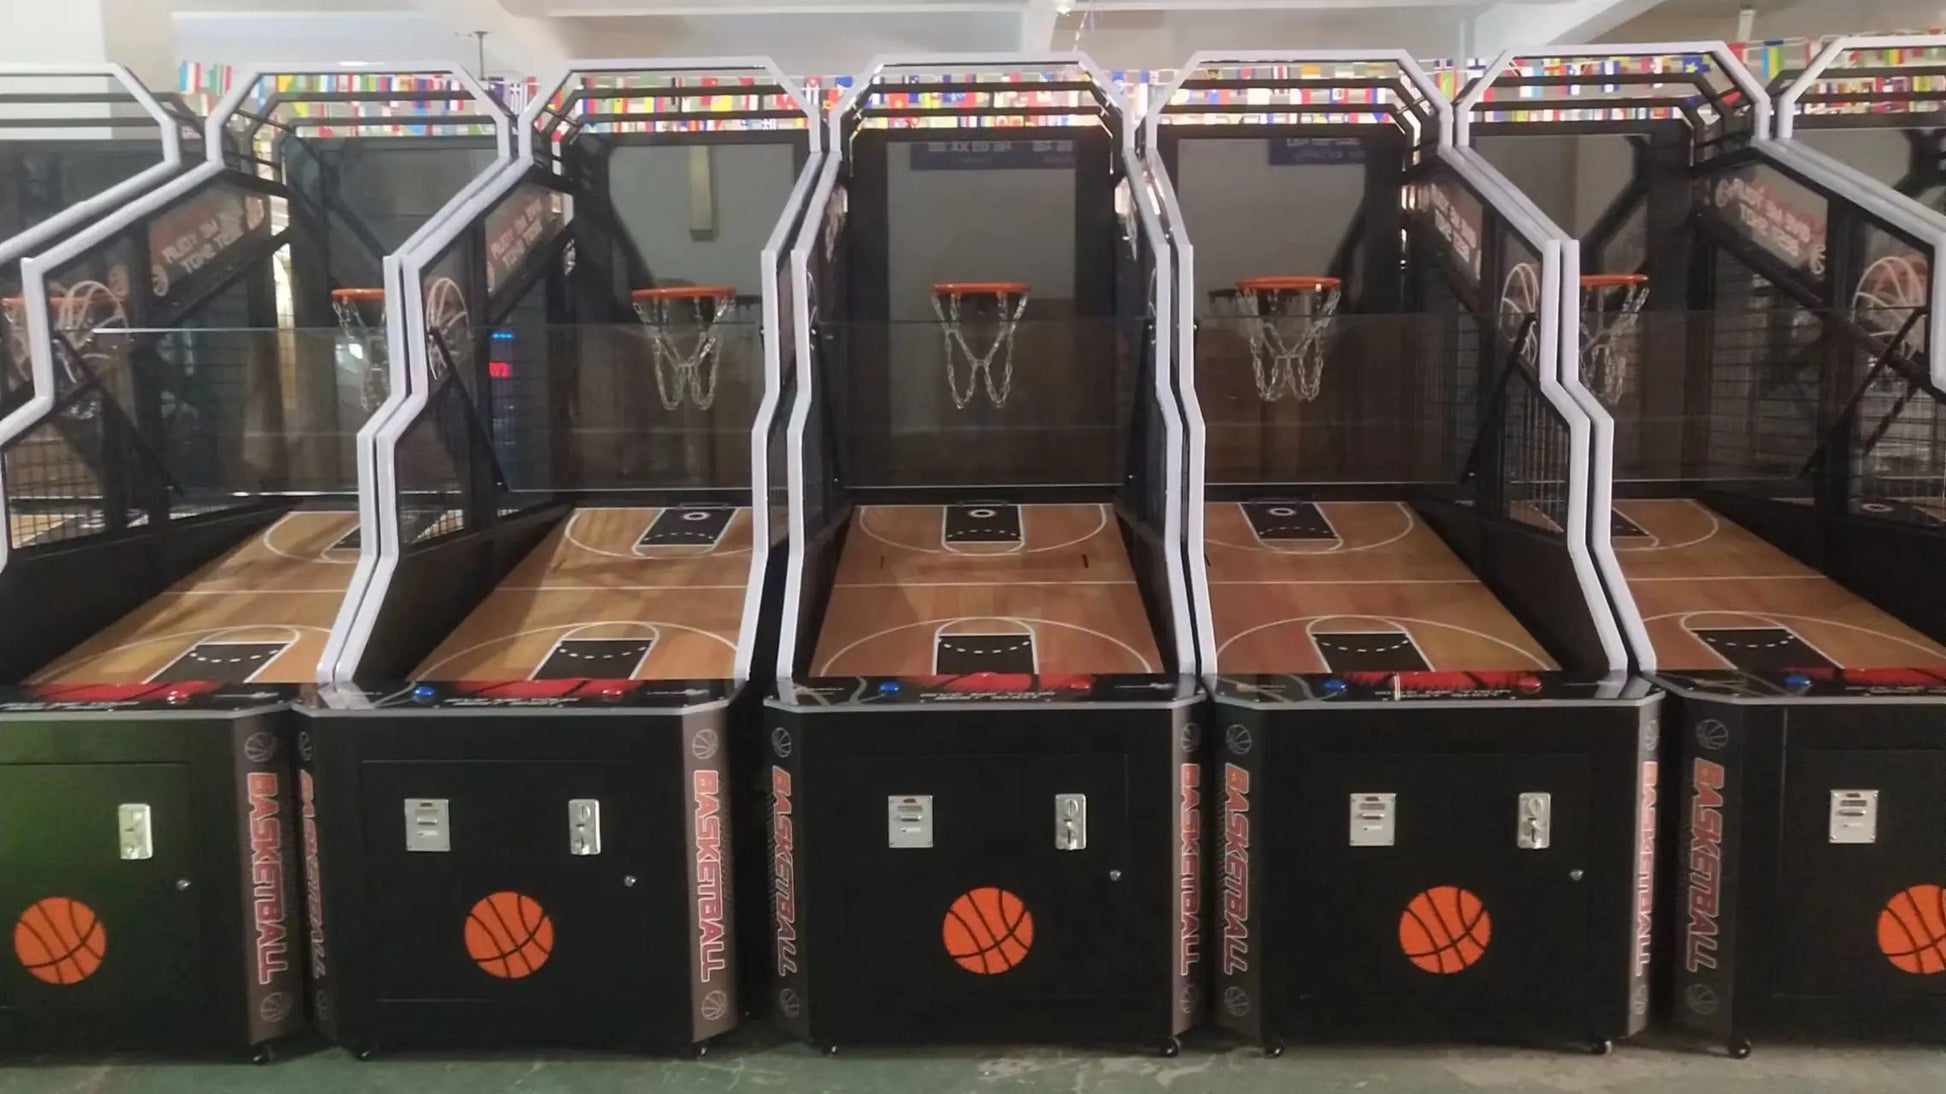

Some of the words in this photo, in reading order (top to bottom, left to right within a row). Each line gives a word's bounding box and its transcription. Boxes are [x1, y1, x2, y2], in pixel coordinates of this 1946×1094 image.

[247, 772, 288, 984] BASKETBALL
[694, 769, 725, 983] BASKETBALL
[772, 765, 797, 977] BASKETBALL
[1180, 763, 1200, 976] BASKETBALL
[1224, 762, 1249, 975] BASKETBALL
[1687, 757, 1725, 972] BASKETBALL
